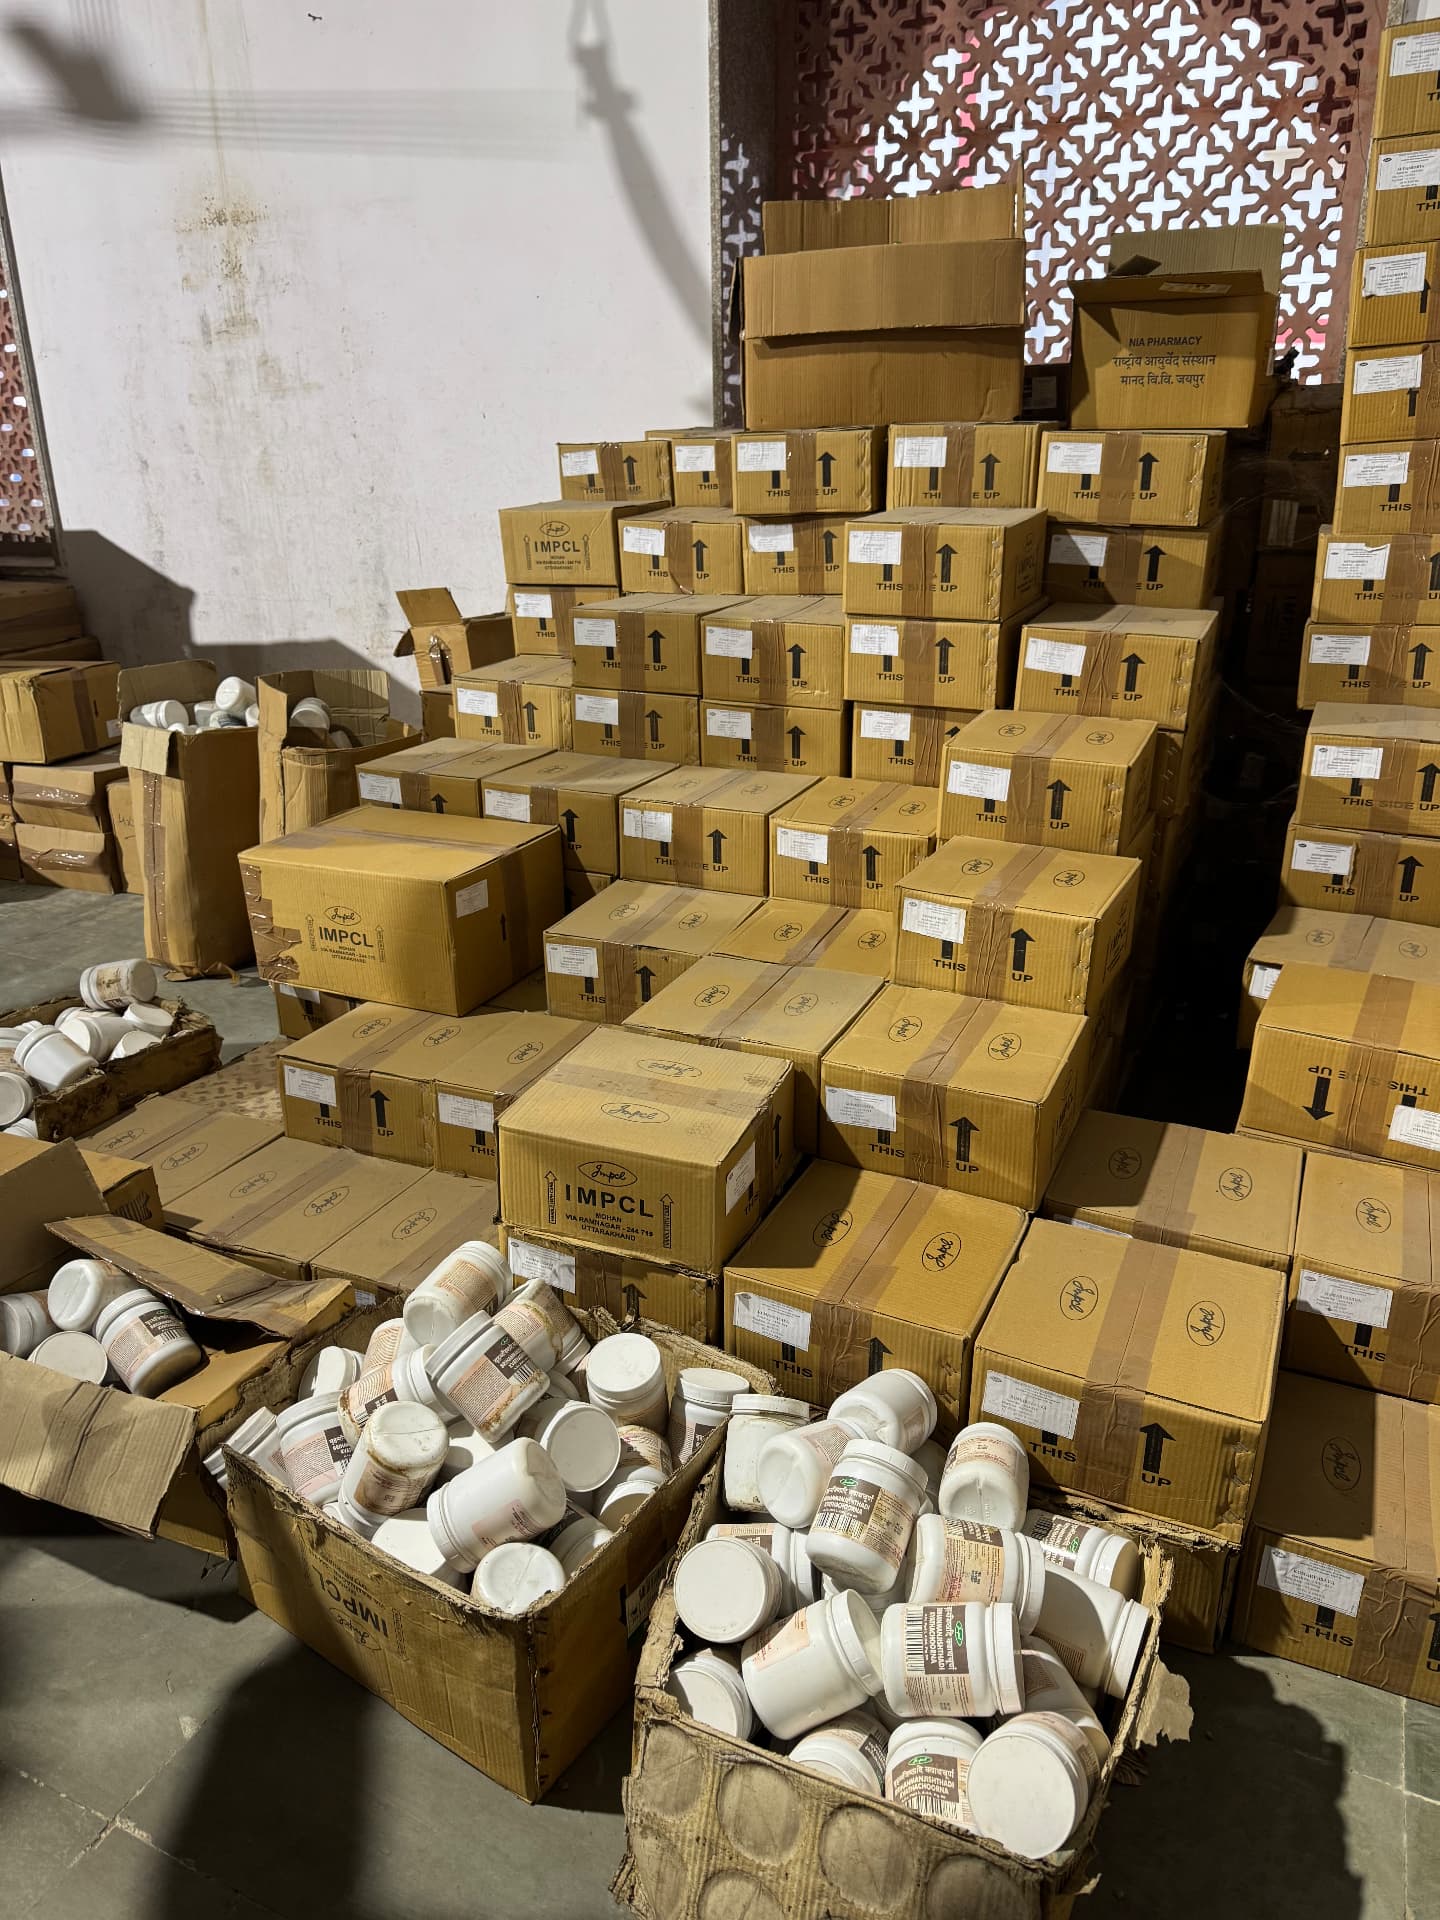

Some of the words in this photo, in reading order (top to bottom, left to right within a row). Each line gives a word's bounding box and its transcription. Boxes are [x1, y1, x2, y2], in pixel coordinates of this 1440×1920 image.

[1128, 337, 1145, 346] NIA
[1147, 336, 1202, 346] PHARMACY
[1182, 352, 1216, 366] संस्थान
[1176, 374, 1206, 388] जयपुर
[822, 488, 838, 496] UP
[984, 491, 1001, 500] UP
[1074, 491, 1101, 500] THIS
[1140, 492, 1158, 500] UP
[1379, 503, 1412, 512] THIS
[534, 540, 580, 552] IMPCL
[648, 570, 669, 578] THIS
[772, 566, 795, 574] THIS
[826, 564, 840, 572] UP
[876, 583, 903, 591] THIS
[940, 584, 958, 592] UP
[1145, 583, 1163, 592] UP
[1354, 592, 1384, 600] THIS
[736, 675, 760, 684] THIS
[876, 672, 904, 682] THIS
[939, 676, 956, 684] UP
[1340, 680, 1370, 688] THIS
[1124, 692, 1143, 702] UP
[480, 728, 501, 736] THIS
[650, 742, 666, 750] UP
[792, 759, 807, 768] UP
[888, 758, 914, 766] THIS
[1340, 797, 1374, 807] THIS
[1378, 800, 1414, 810] SIDE
[1418, 802, 1440, 812] UP
[976, 814, 1008, 824] THIS
[1050, 822, 1070, 830] UP
[713, 864, 728, 873] UP
[802, 875, 830, 884] THIS
[866, 882, 884, 890] UP
[1399, 894, 1420, 902] UP
[319, 926, 374, 948] IMPCL
[932, 958, 966, 972] THIS
[1012, 973, 1034, 983] UP
[578, 994, 606, 1004] THIS
[1308, 1065, 1332, 1077] UP
[1388, 1081, 1430, 1096] THIS
[314, 1117, 342, 1129] THIS
[377, 1128, 394, 1137] UP
[868, 1144, 904, 1158] THIS
[956, 1162, 980, 1174] UP
[592, 1164, 626, 1184] Impcl
[565, 1184, 654, 1218] IMPCL
[566, 1214, 578, 1222] VIA
[579, 1216, 620, 1230] RAMNAGAR
[596, 1212, 622, 1223] MOHAN
[582, 1224, 636, 1241] UTTARAKHAND
[1344, 1344, 1386, 1362] THIS
[772, 1360, 814, 1378] THIS
[1028, 1442, 1078, 1462] THIS
[1141, 1474, 1172, 1487] UP
[312, 1564, 389, 1638] IMPCL
[1302, 1623, 1354, 1647] THIS
